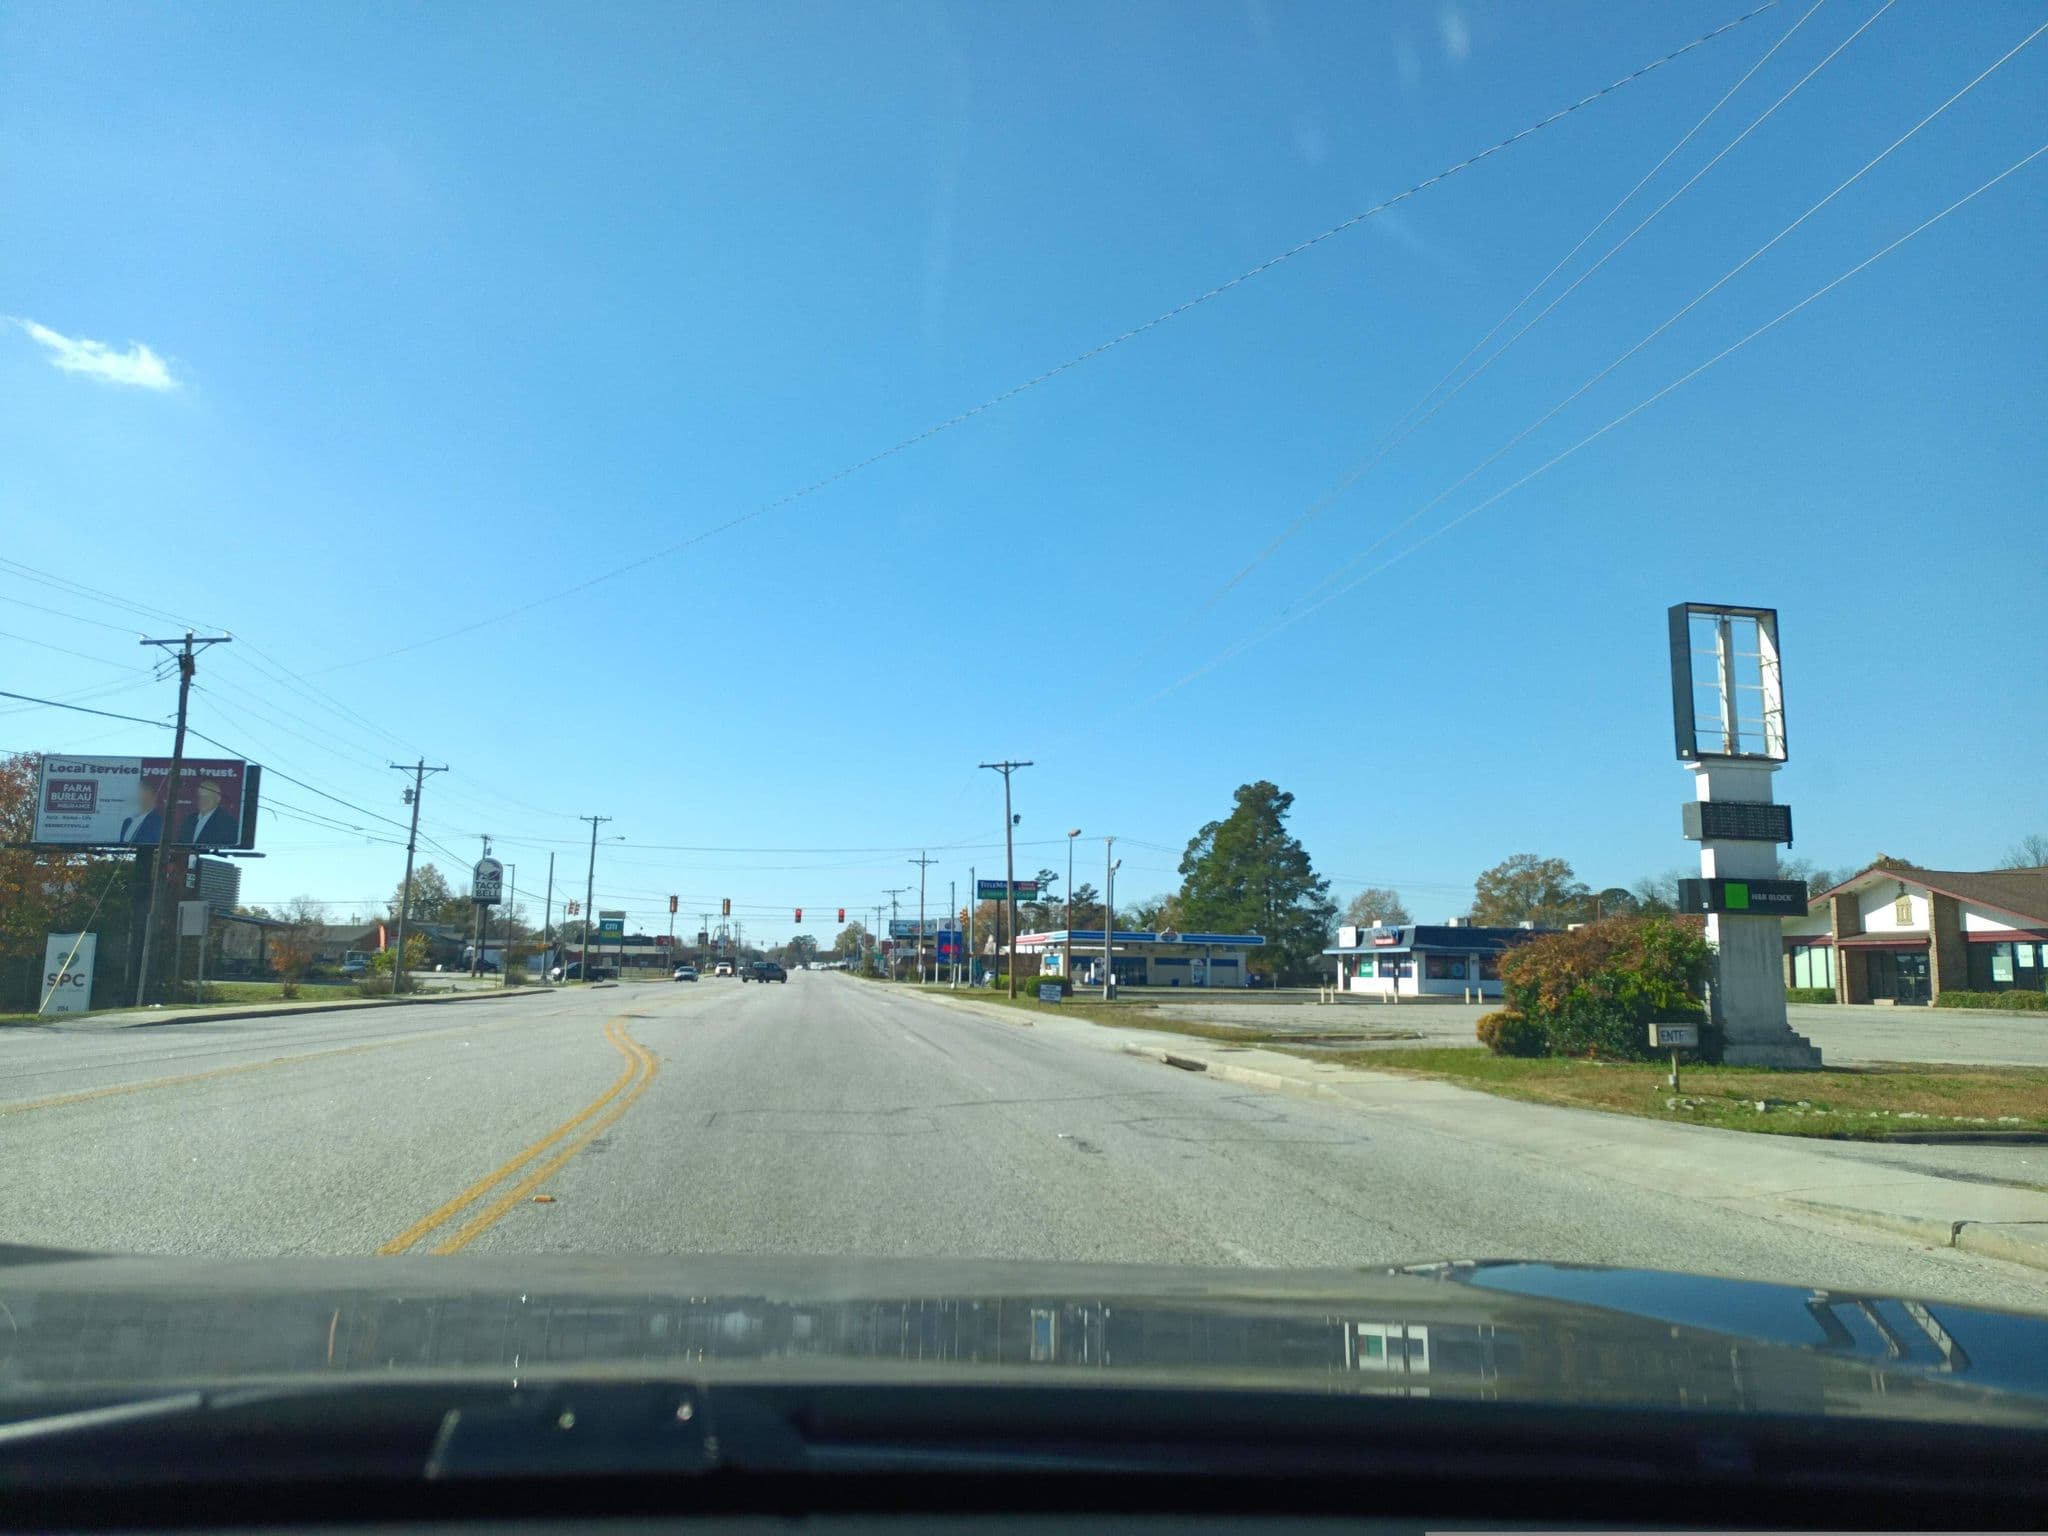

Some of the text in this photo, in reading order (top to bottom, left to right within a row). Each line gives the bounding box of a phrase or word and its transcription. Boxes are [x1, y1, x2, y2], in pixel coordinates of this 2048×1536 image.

[49, 763, 86, 774] Local
[89, 764, 139, 775] service
[143, 767, 171, 777] you
[200, 767, 238, 777] trust.
[63, 783, 92, 793] FARM
[50, 792, 92, 801] BUREAU
[47, 973, 85, 987] SPC
